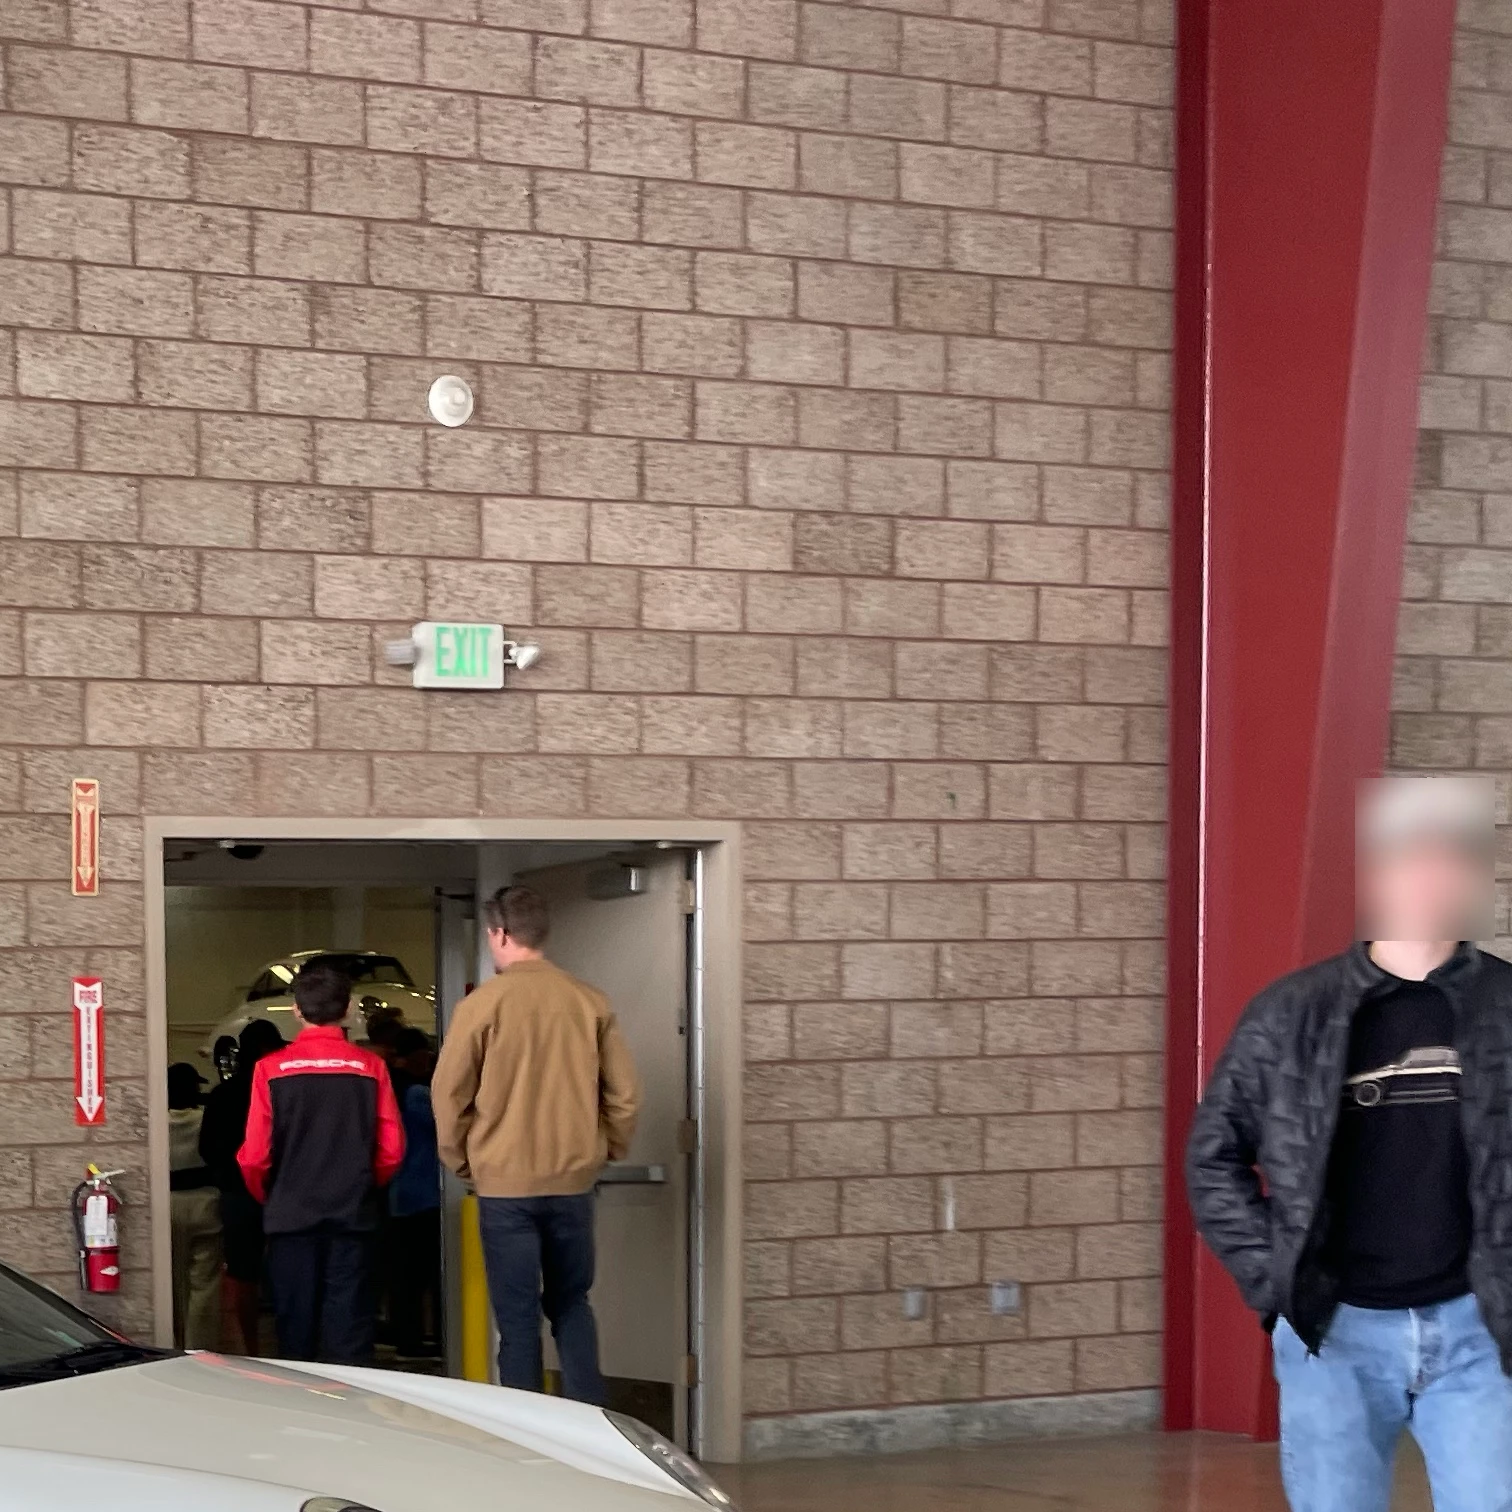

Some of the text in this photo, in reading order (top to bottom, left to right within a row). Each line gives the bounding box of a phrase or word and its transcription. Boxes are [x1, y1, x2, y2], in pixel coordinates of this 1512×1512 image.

[435, 625, 493, 677] EXIT
[85, 1006, 94, 1114] EXTINGUISHER
[279, 1059, 365, 1072] PORSCHE
